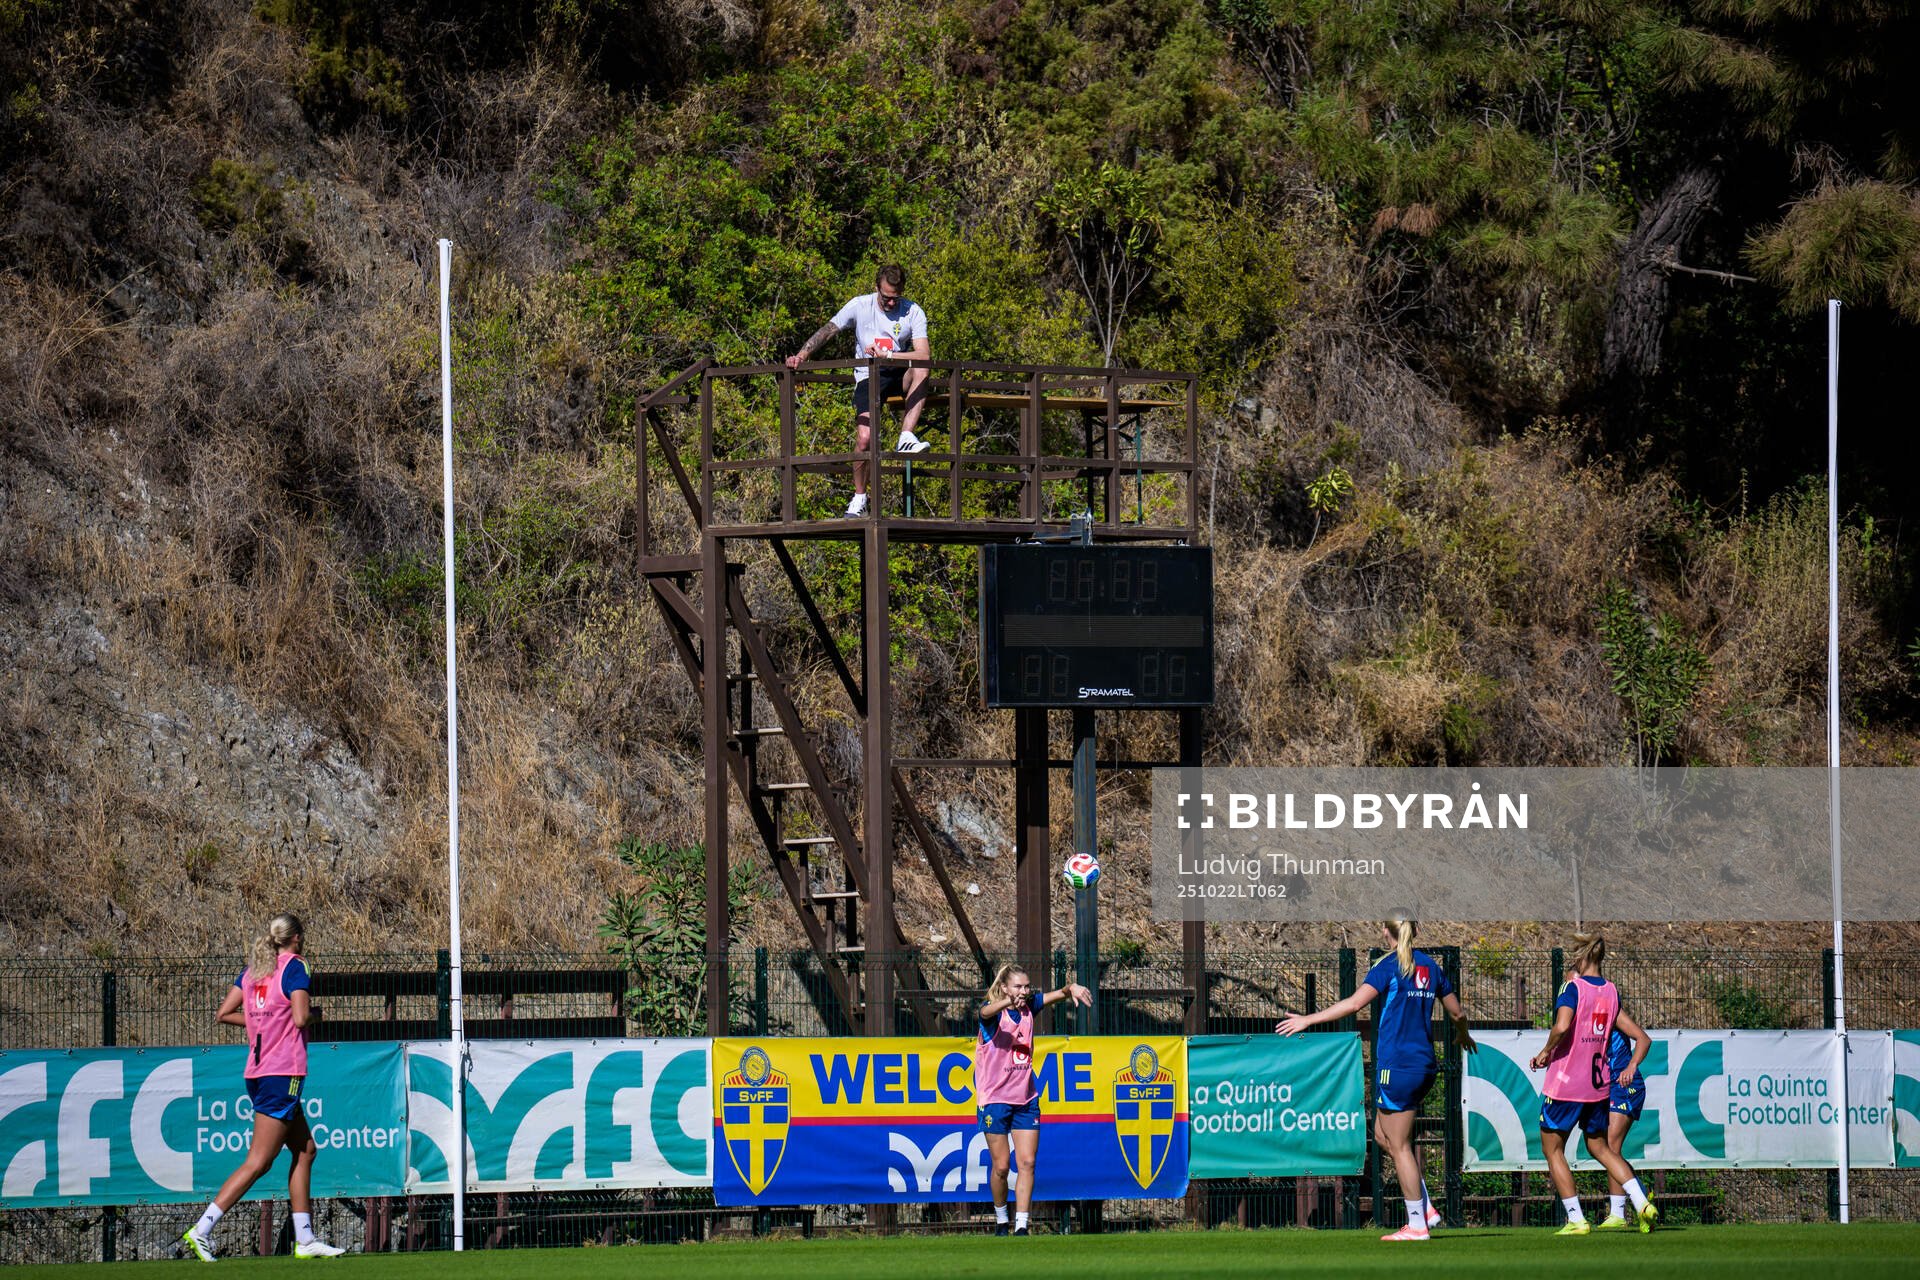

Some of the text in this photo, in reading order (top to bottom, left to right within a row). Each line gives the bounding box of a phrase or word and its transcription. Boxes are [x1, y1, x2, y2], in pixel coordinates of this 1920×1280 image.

[1078, 687, 1134, 698] STRAMATEL
[809, 1052, 1095, 1105] WELCME
[1591, 1052, 1604, 1090] 6
[739, 1090, 774, 1102] SvFF
[1129, 1087, 1161, 1099] SvFF
[1190, 1078, 1292, 1107] a Quinta
[1727, 1073, 1828, 1099] La Quinta
[197, 1095, 227, 1121] La
[1190, 1107, 1360, 1134] ootball Center
[1727, 1101, 1812, 1125] Football
[311, 1123, 400, 1149] Center
